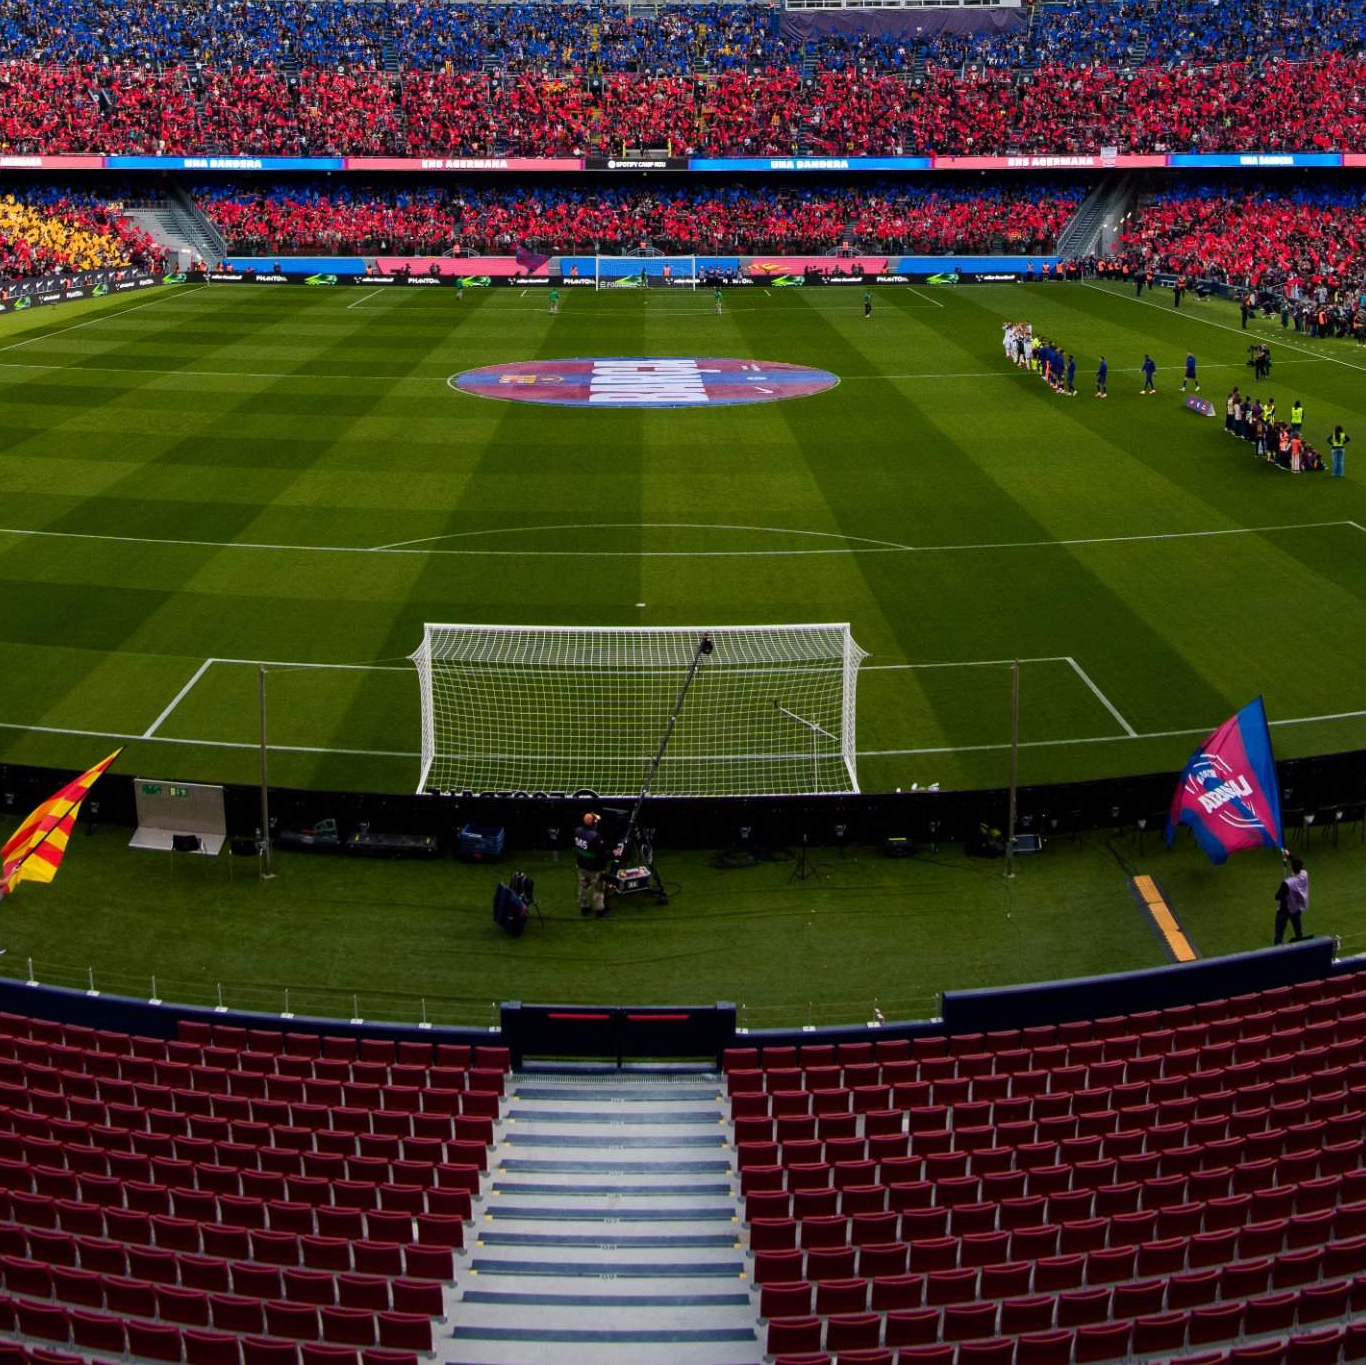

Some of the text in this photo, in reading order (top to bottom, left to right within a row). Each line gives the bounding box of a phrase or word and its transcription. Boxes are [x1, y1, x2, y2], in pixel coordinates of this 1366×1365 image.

[184, 159, 262, 169] UNA BANDERA
[421, 160, 508, 169] ENS AGERMANA
[770, 160, 848, 169] UNA BANDERA
[1008, 157, 1094, 167] ENS AGERMANA
[589, 359, 721, 402] BARÇA
